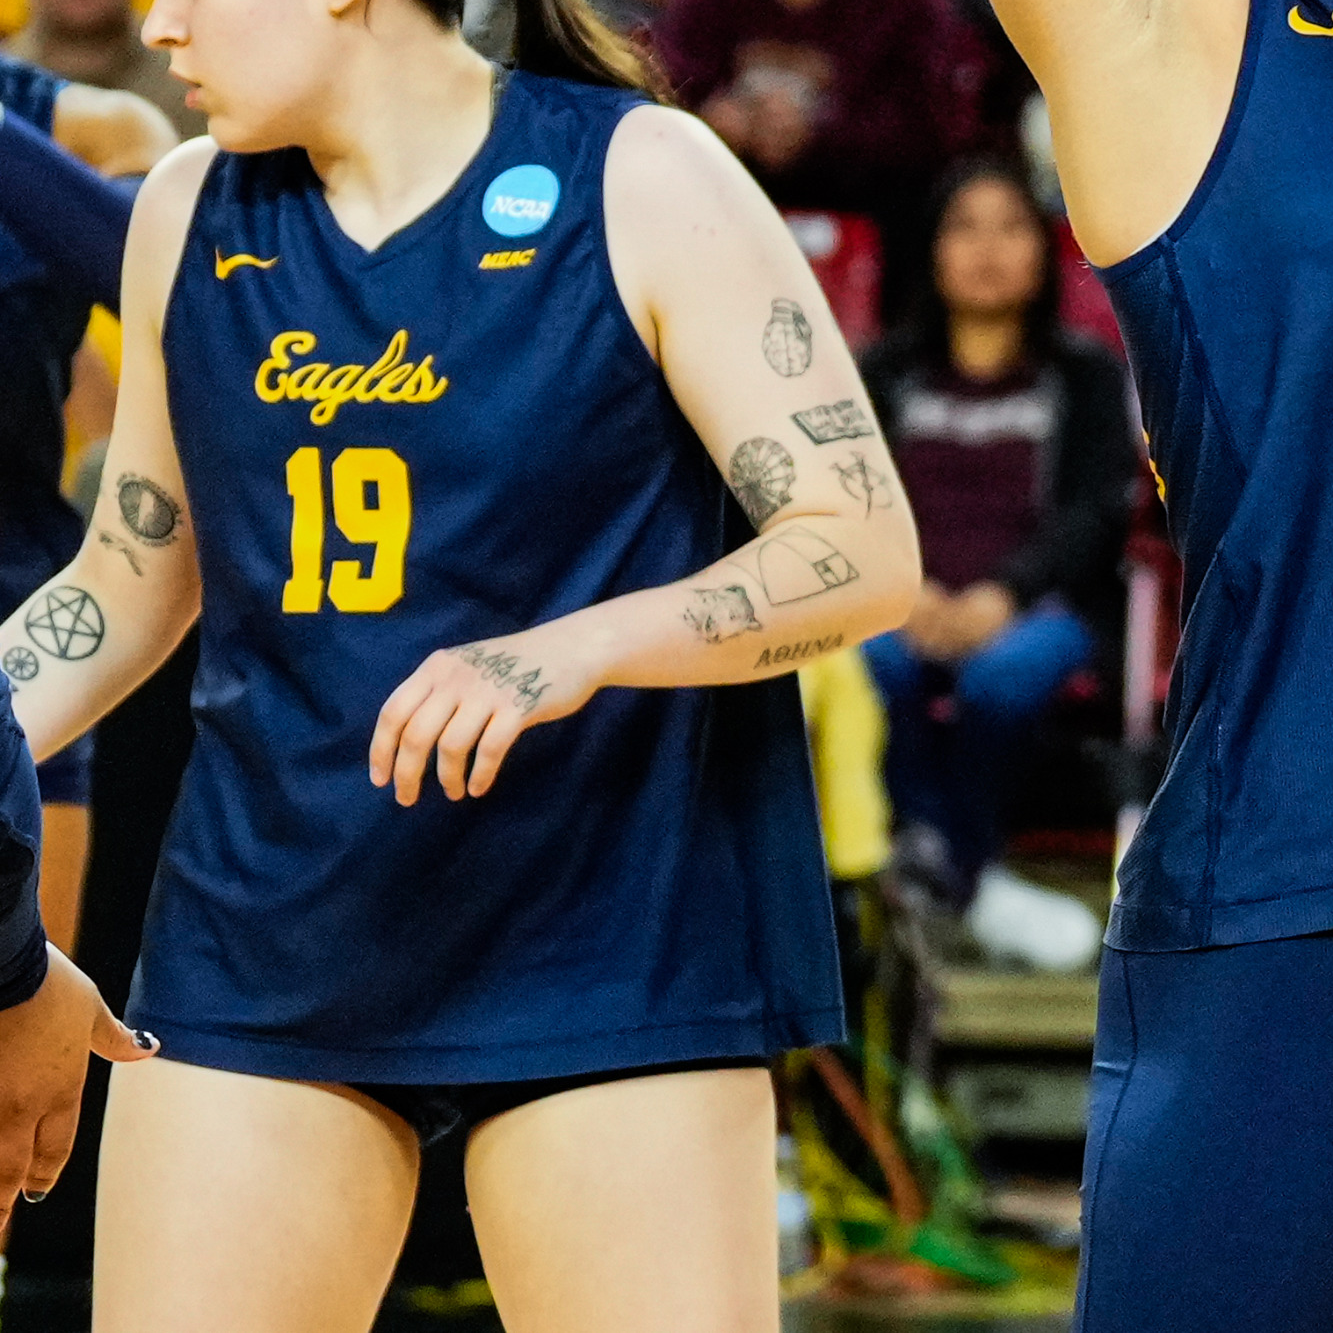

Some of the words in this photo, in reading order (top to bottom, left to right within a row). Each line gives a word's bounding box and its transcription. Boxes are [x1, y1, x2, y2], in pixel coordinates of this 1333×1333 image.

[490, 195, 552, 220] NCAA
[255, 328, 448, 426] Eagles
[282, 446, 412, 614] 19
